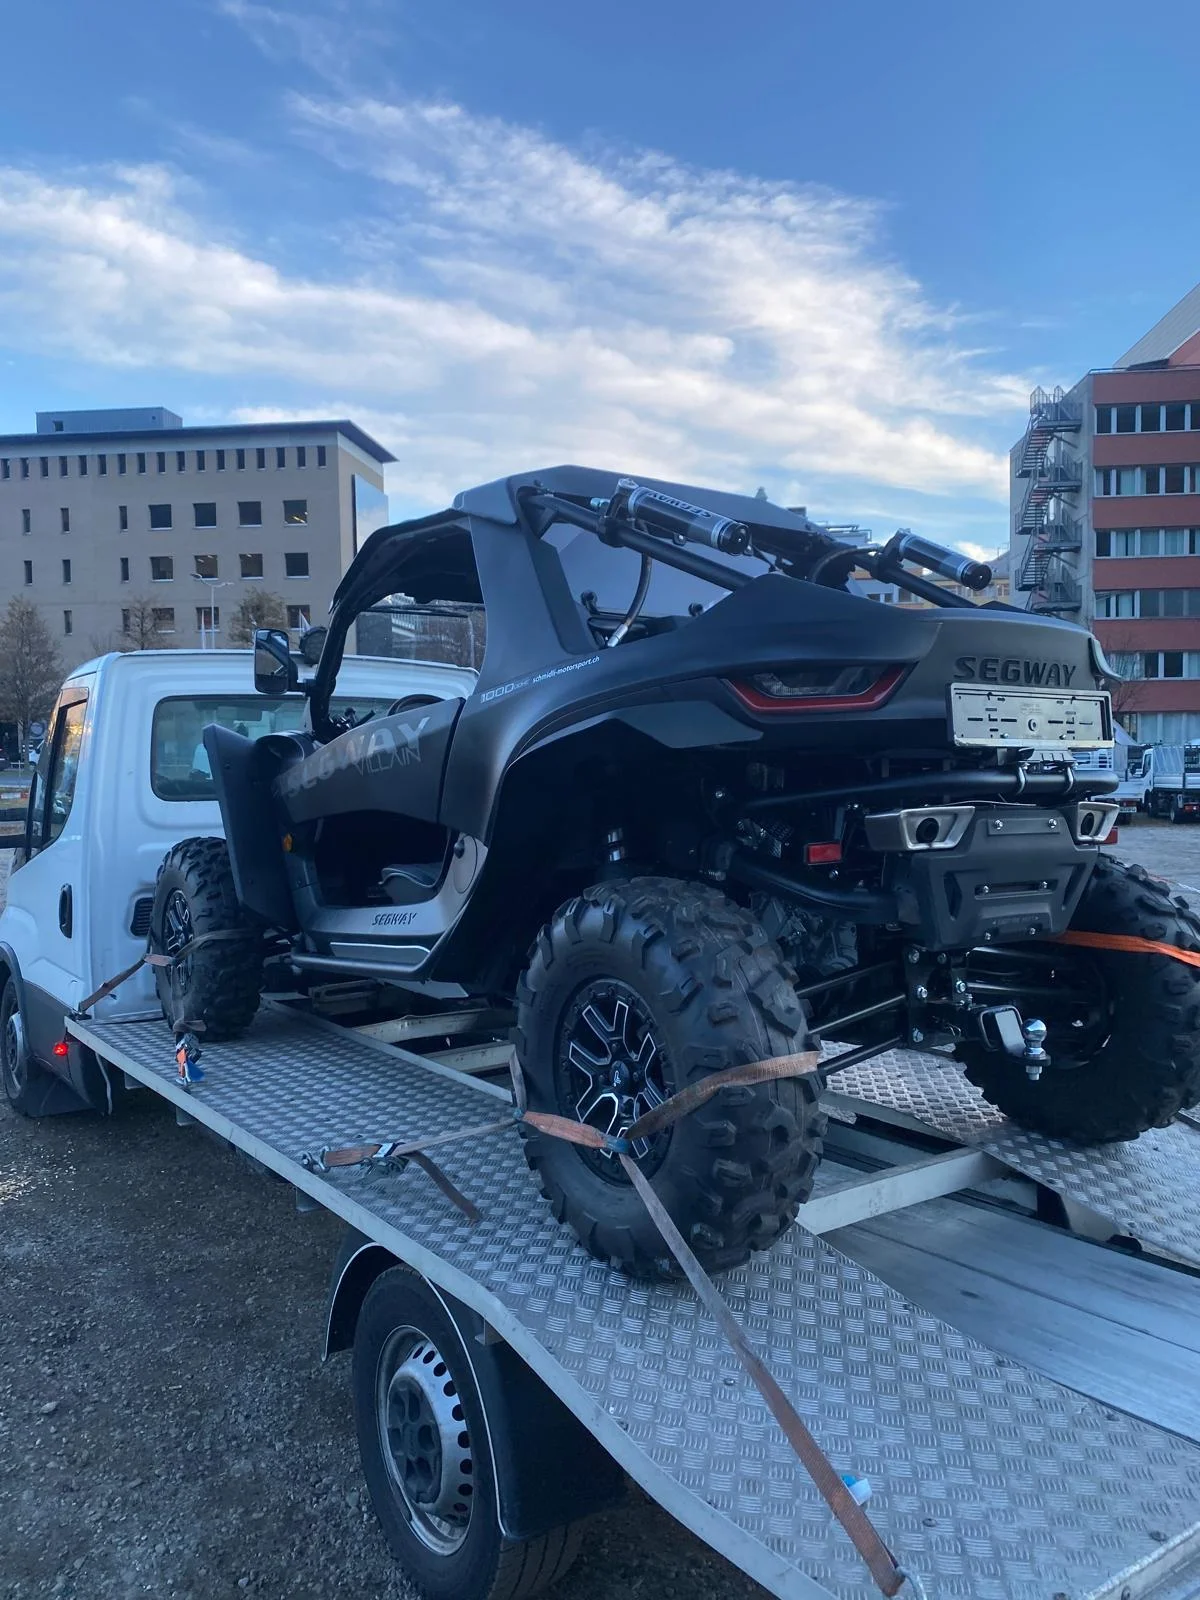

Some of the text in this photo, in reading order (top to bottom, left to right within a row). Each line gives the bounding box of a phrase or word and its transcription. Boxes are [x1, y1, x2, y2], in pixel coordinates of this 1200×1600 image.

[953, 656, 1077, 688] SEGWAY
[481, 683, 514, 704] 1000
[352, 746, 423, 777] VILLAIN
[372, 912, 418, 926] SEGWAY
